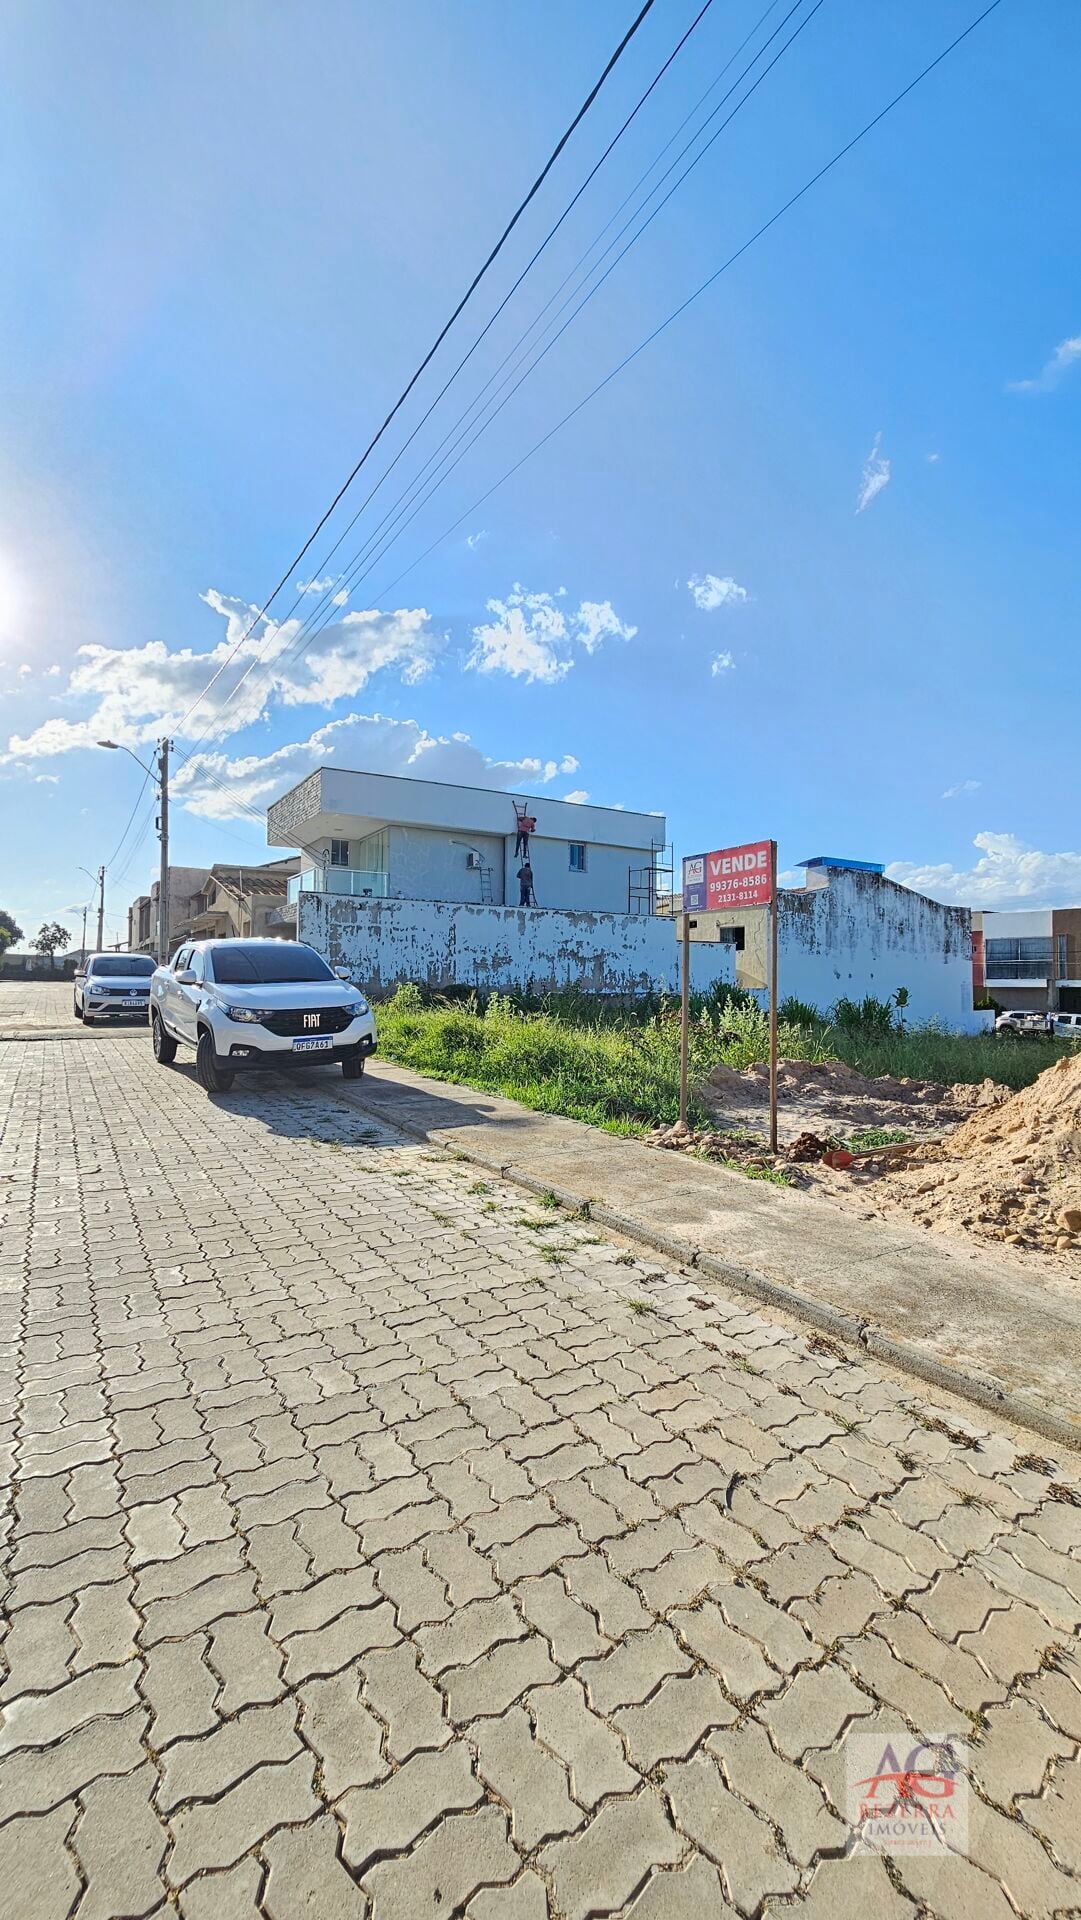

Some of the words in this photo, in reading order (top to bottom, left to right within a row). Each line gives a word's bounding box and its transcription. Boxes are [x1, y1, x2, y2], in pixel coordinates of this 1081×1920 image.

[709, 850, 768, 876] VENDE
[710, 874, 767, 892] 99376-8586
[718, 890, 758, 903] 2131-8114
[303, 1014, 320, 1028] FIAT
